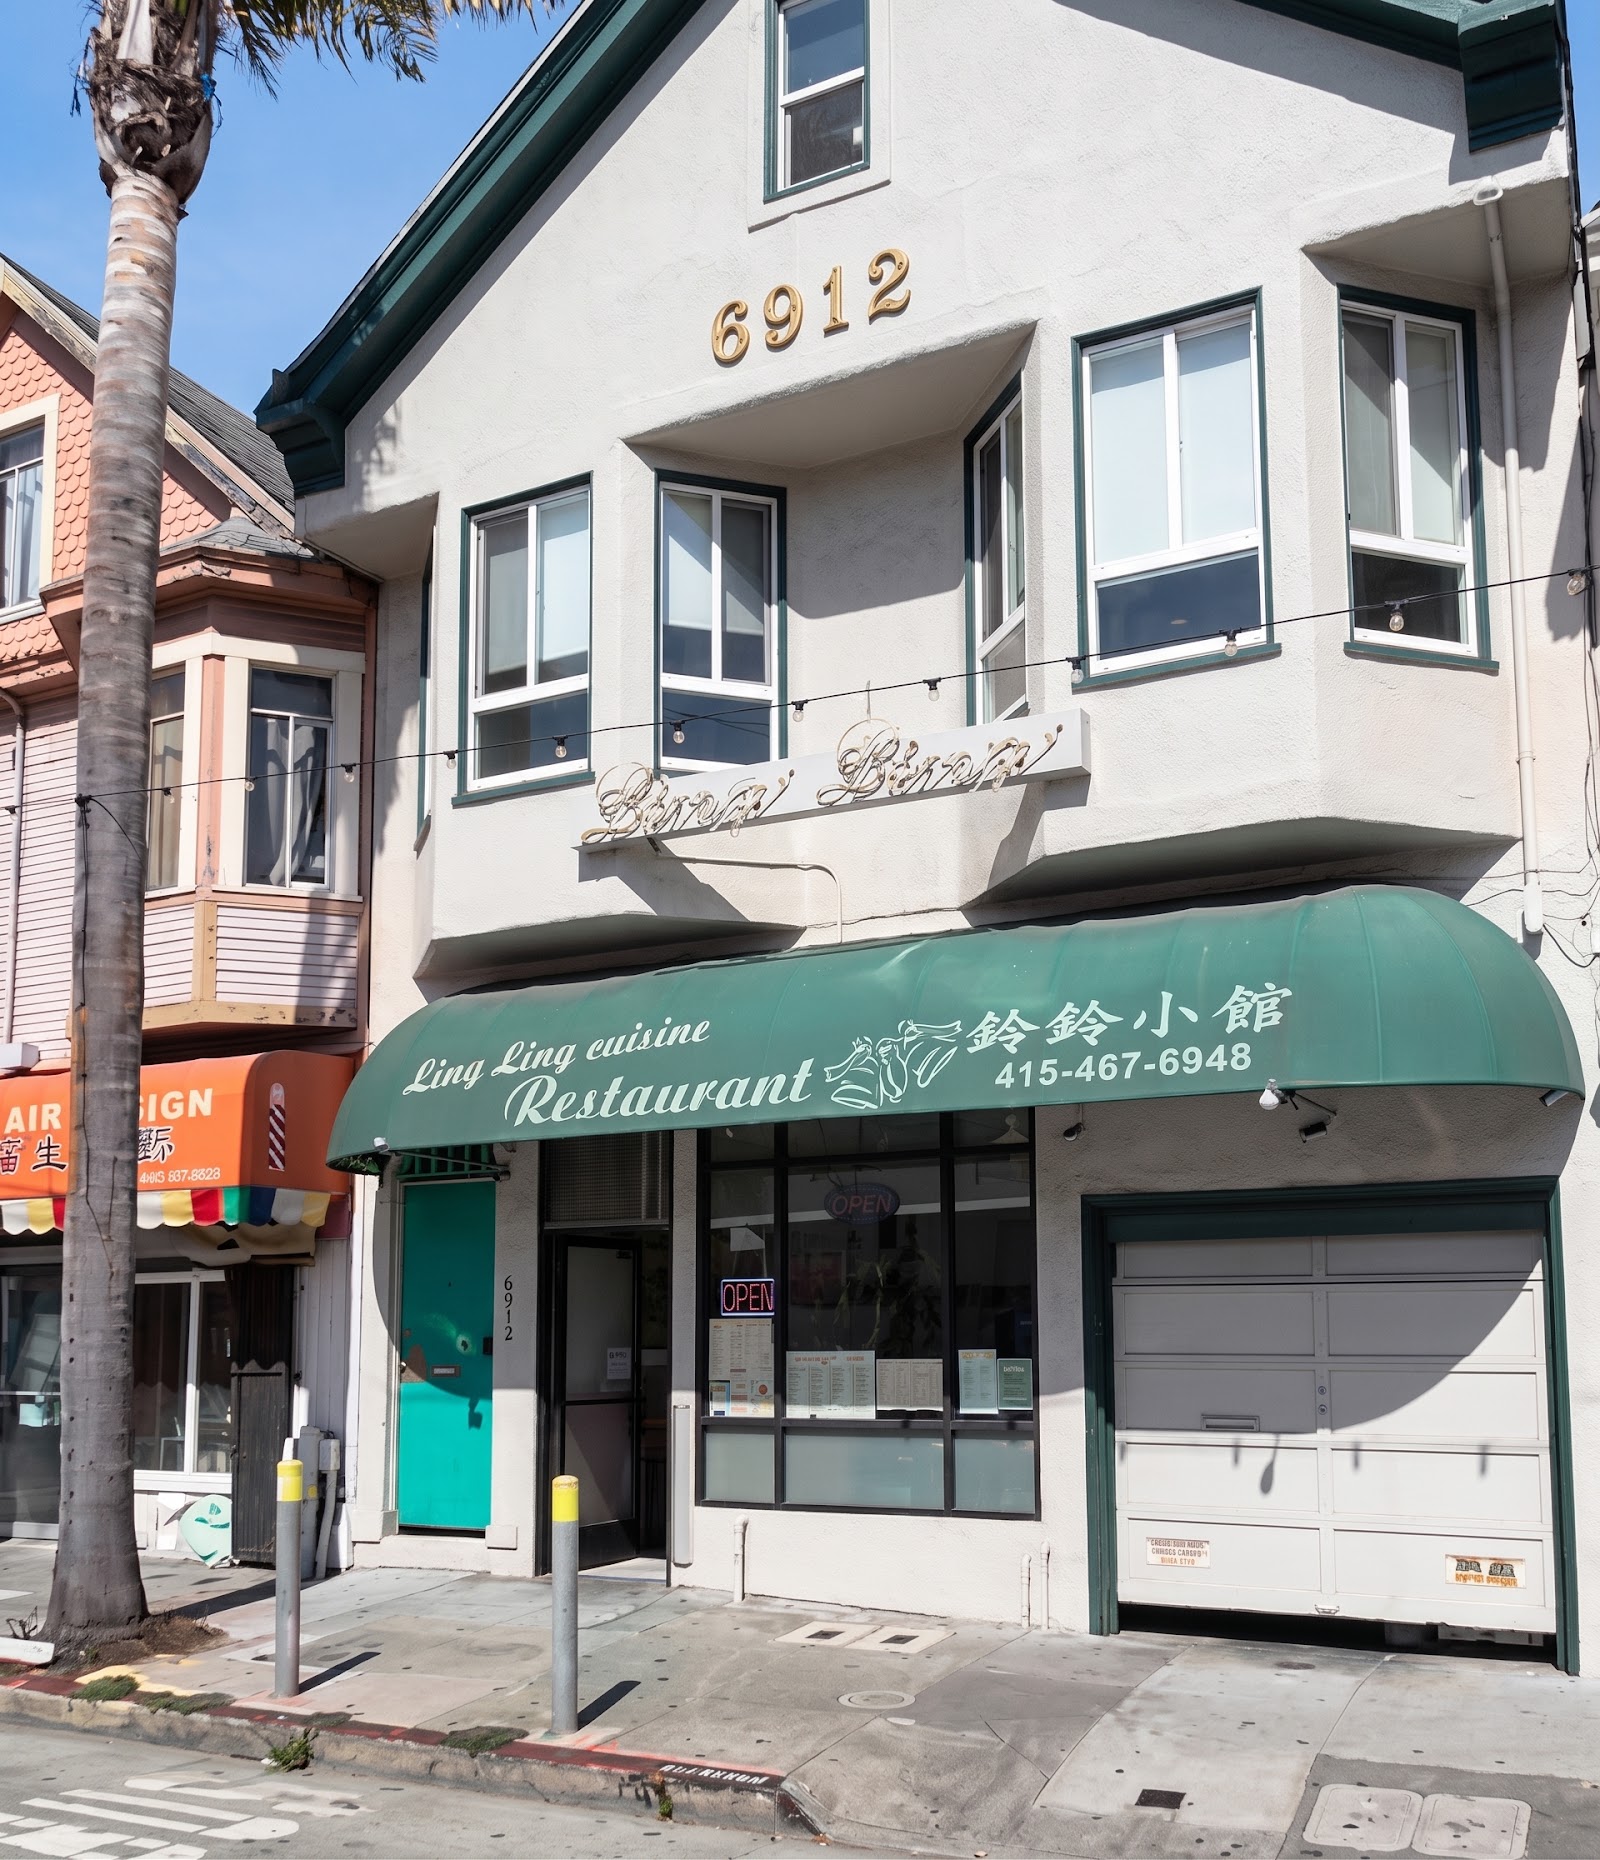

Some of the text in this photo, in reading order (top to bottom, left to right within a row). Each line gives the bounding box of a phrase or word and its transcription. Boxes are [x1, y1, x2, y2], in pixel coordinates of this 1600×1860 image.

[711, 249, 912, 363] 6912
[965, 982, 1293, 1055] 鈴鈴小館
[402, 1016, 710, 1096] Ling Ling cuisine
[994, 1042, 1252, 1089] 415-467-6948
[504, 1057, 815, 1127] Restaurant
[831, 1193, 892, 1216] OPEN
[504, 1275, 513, 1341] 6912
[722, 1283, 774, 1312] OPEN
